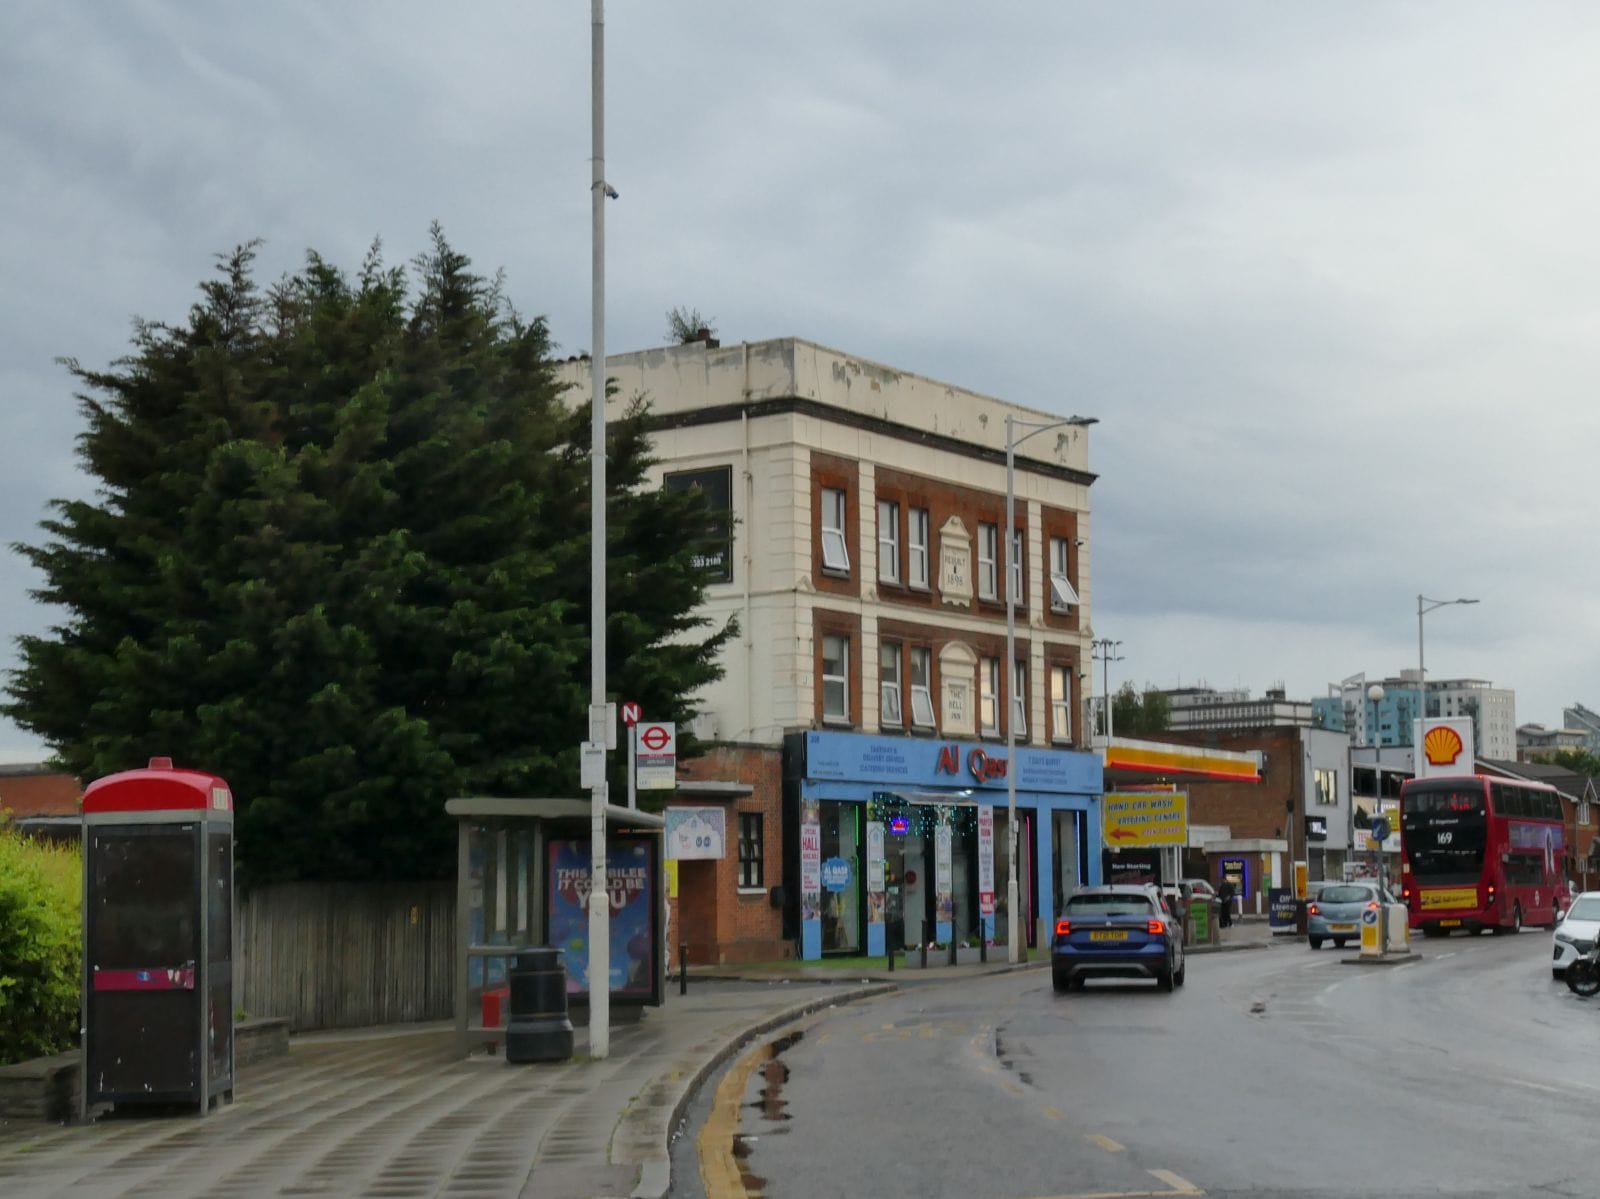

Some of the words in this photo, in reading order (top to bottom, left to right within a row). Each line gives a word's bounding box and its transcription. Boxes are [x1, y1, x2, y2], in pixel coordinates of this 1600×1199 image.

[623, 704, 638, 722] N
[936, 744, 960, 775] Al
[1151, 800, 1173, 809] WASH
[803, 838, 818, 851] HALL
[1437, 832, 1453, 845] 169
[557, 868, 588, 878] THIS
[558, 879, 572, 891] IT
[625, 878, 644, 890] BE
[576, 889, 627, 909] YU
